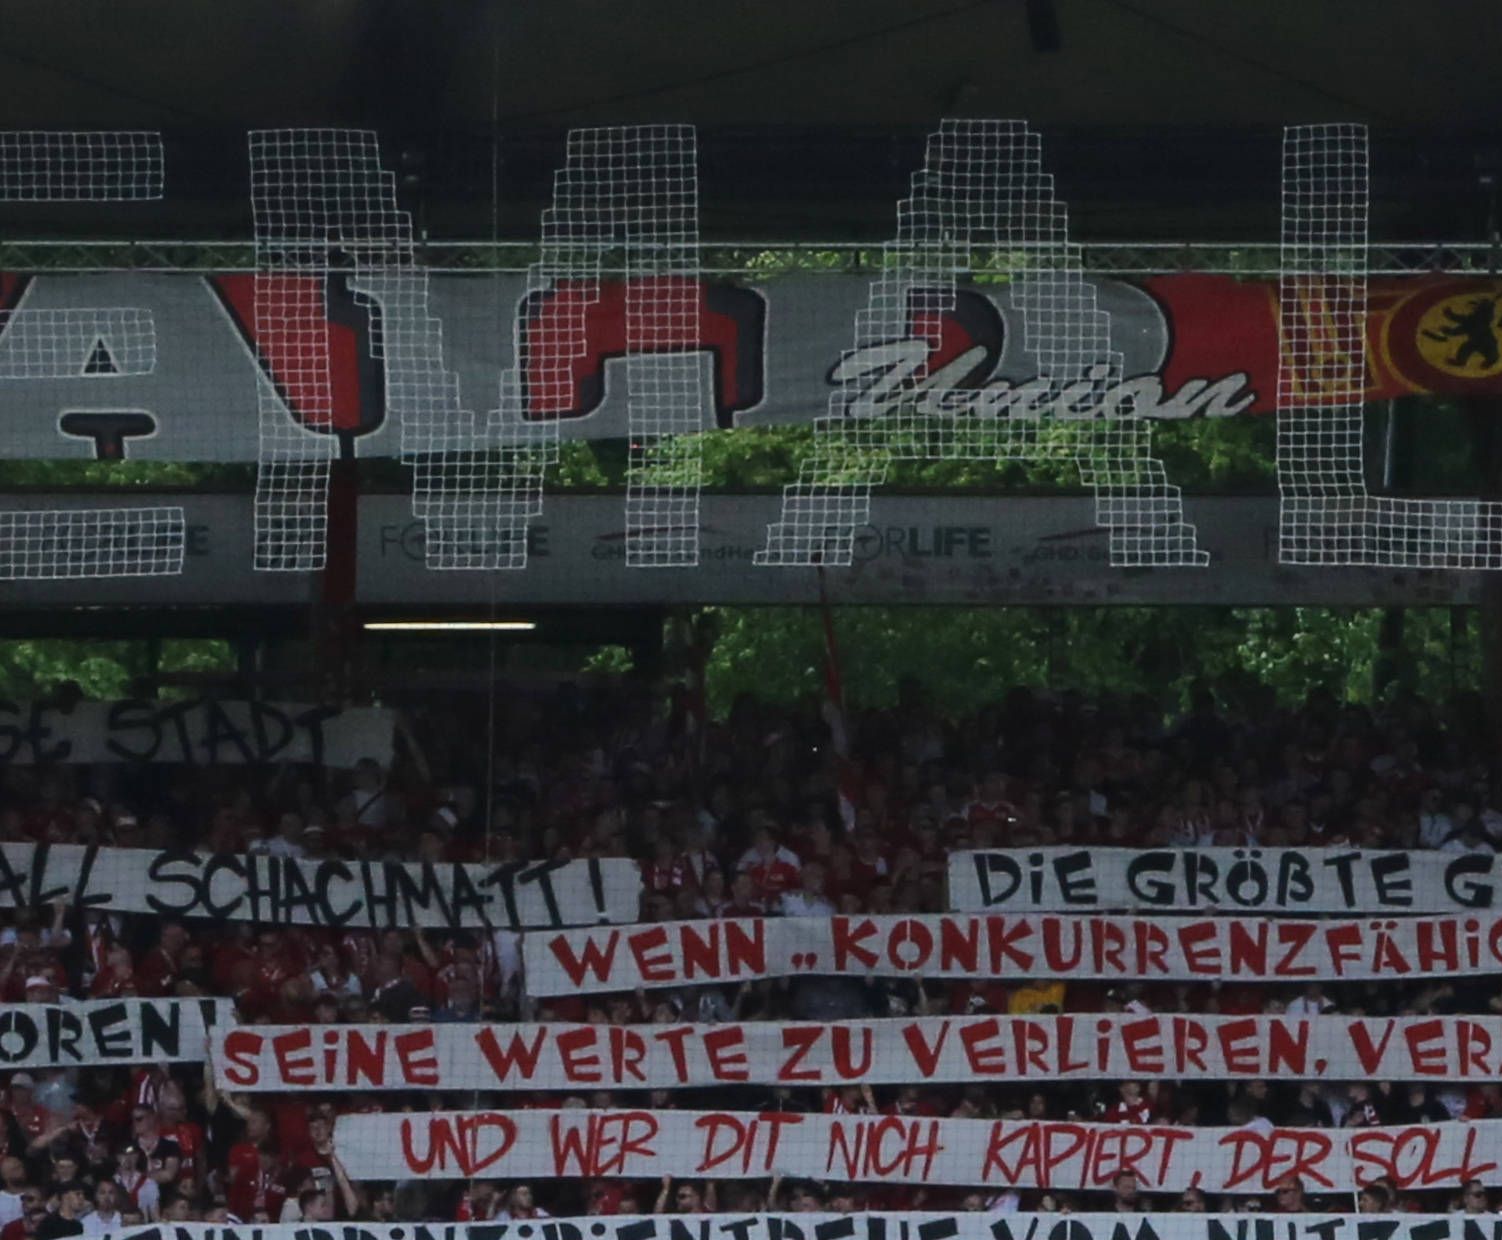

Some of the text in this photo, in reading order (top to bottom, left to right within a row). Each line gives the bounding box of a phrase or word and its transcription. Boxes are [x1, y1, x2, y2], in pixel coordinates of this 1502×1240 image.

[106, 699, 345, 766] STADT
[548, 916, 766, 988] WENN
[475, 1026, 749, 1083] WERTE
[778, 1026, 874, 1081] ZU
[401, 1111, 519, 1176] UND
[550, 1111, 659, 1177] WER
[695, 1110, 804, 1173] DIT
[826, 1119, 945, 1181] NICH
[1218, 1127, 1335, 1188] DER
[1348, 1126, 1498, 1188] SOLL
